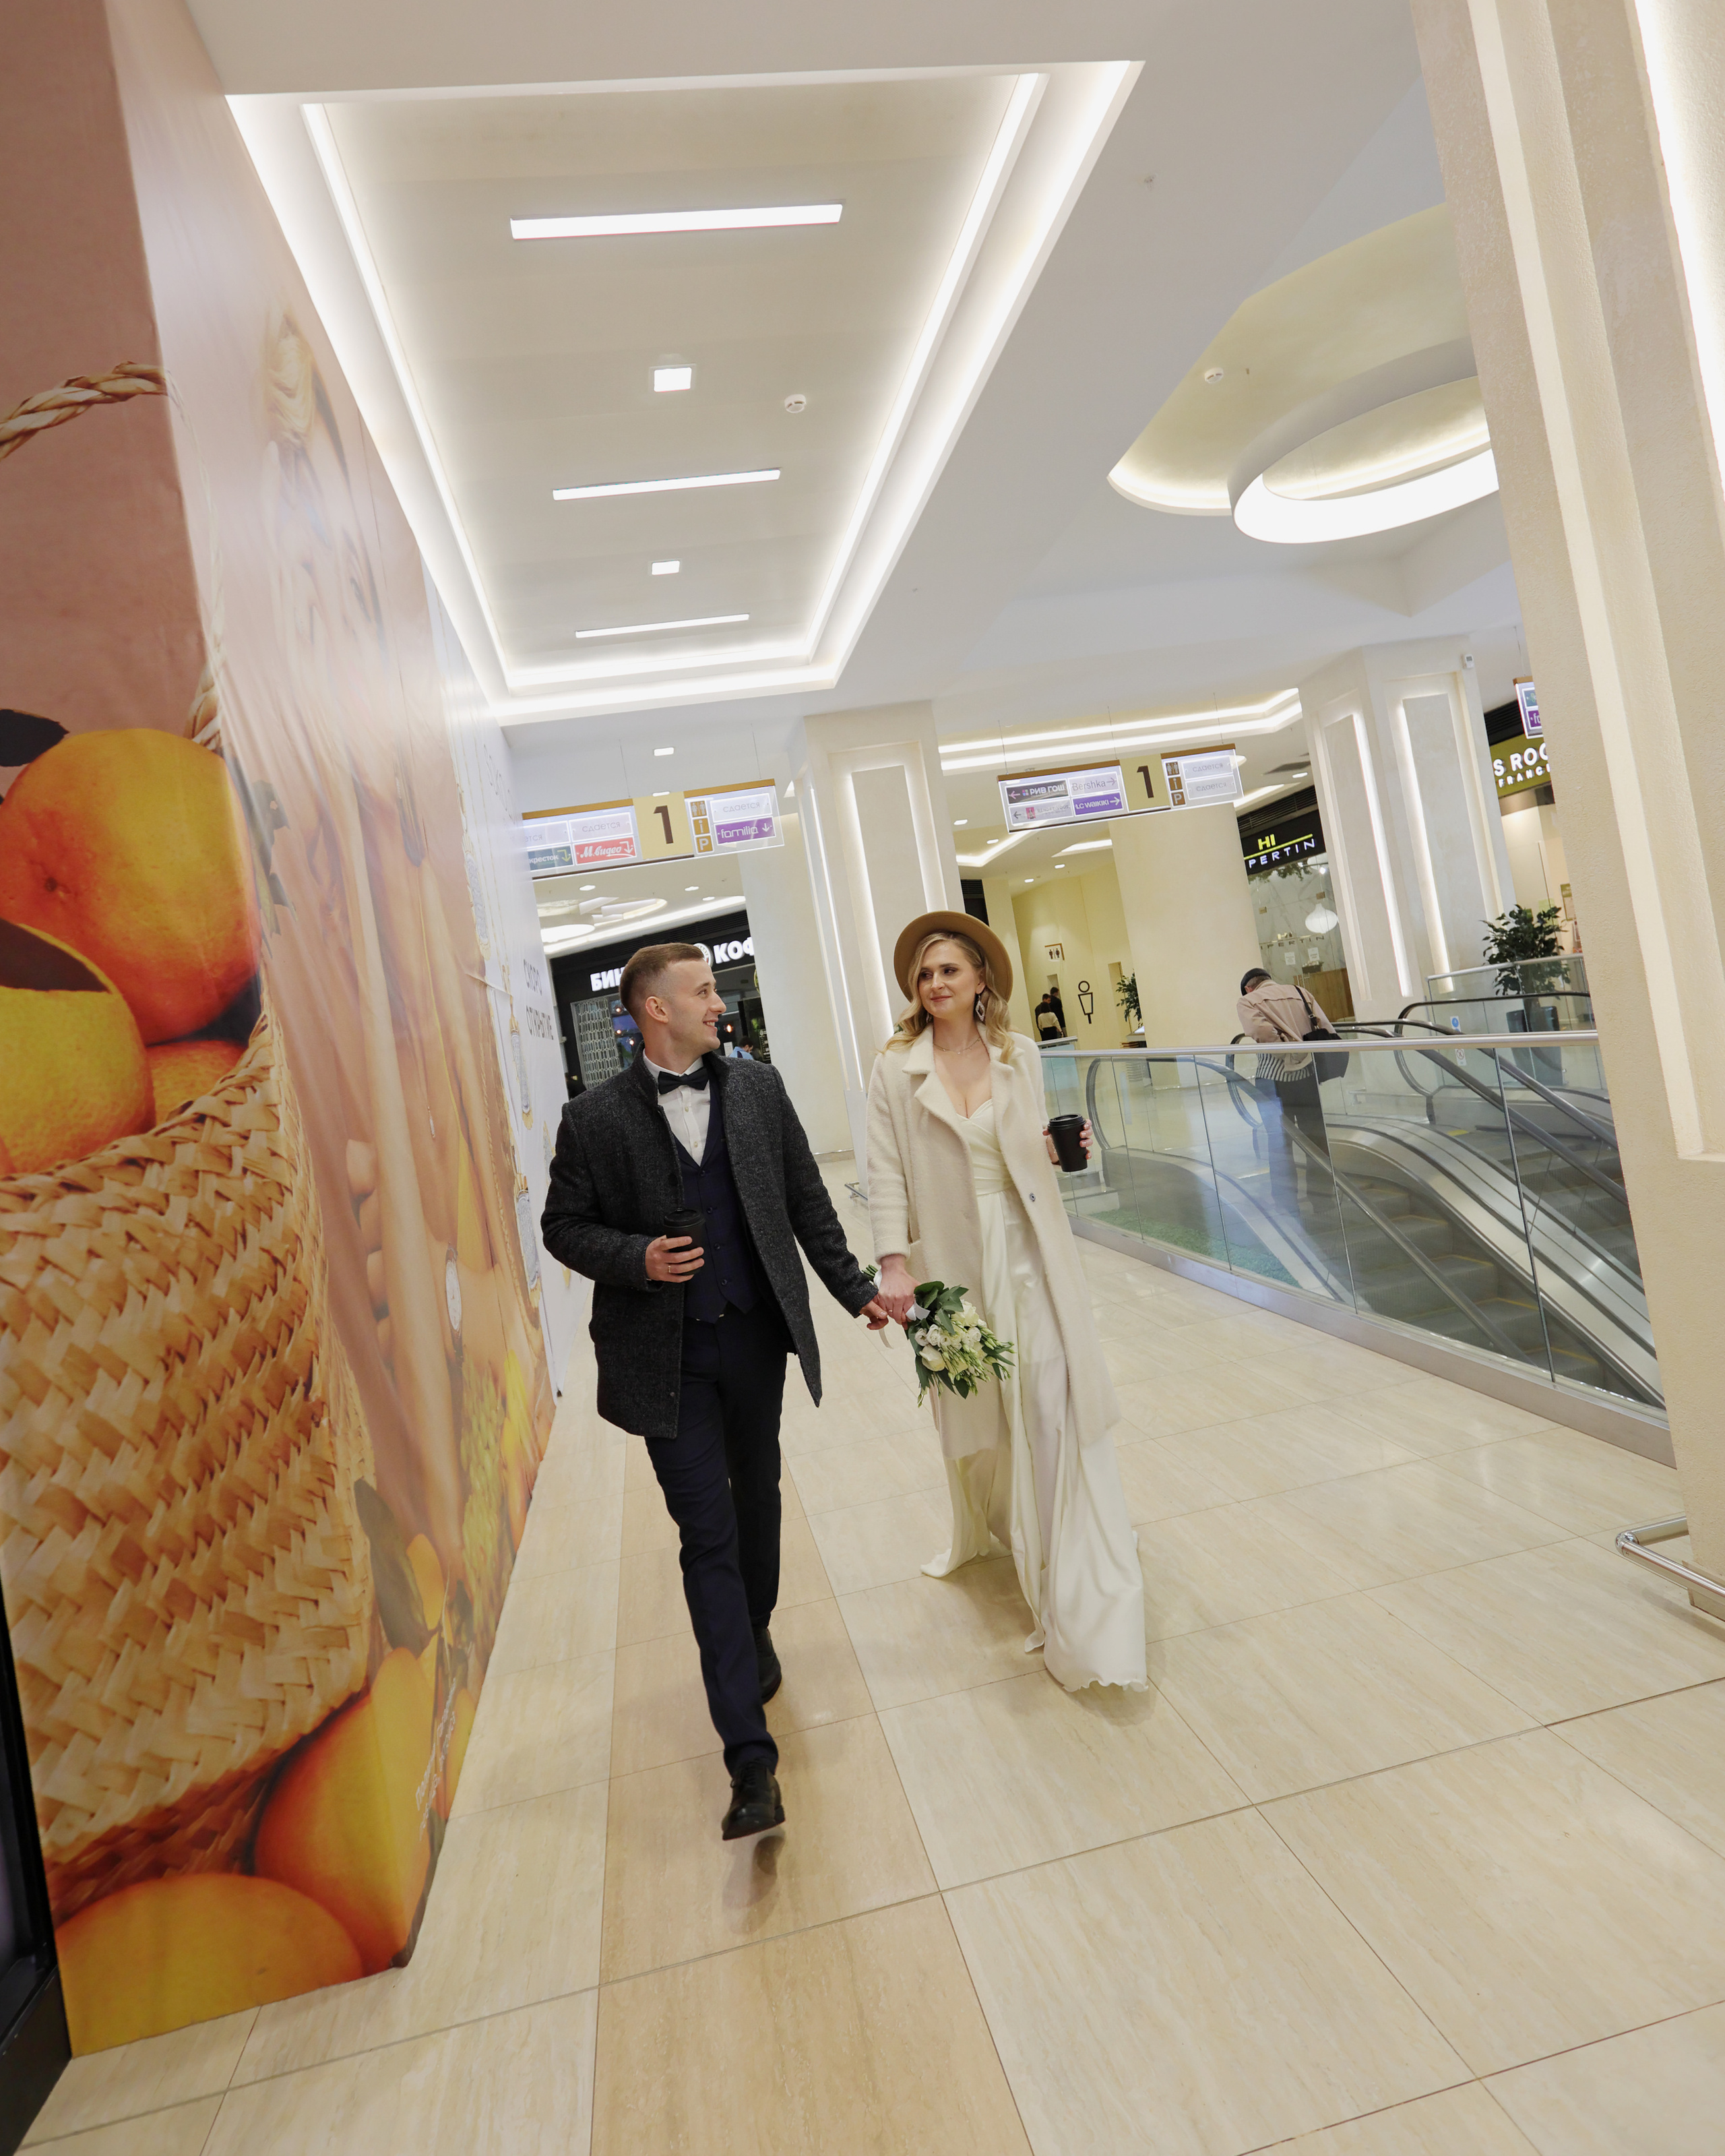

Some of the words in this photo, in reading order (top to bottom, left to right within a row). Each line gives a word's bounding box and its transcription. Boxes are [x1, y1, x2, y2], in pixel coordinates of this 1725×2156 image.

[1510, 743, 1548, 772] ROC
[1193, 762, 1224, 772] сдается
[1137, 765, 1154, 798] 1
[1498, 763, 1550, 788] FRANC
[1030, 787, 1046, 795] РИВ
[1047, 784, 1065, 793] ГОШ
[1072, 780, 1106, 791] Bershka
[1196, 782, 1227, 792] сдается
[722, 801, 760, 813] сдается
[582, 820, 621, 833] сдается
[653, 805, 674, 844] 1
[721, 825, 759, 839] familia
[525, 834, 542, 842] ется
[1257, 834, 1276, 851] HI
[529, 855, 559, 864] кресток
[1248, 838, 1315, 869] PERTIN
[590, 966, 625, 991] БИН
[713, 937, 755, 964] КОФ
[523, 958, 542, 996] СКОРО
[526, 1005, 554, 1041] ОТКРЫТИЕ
